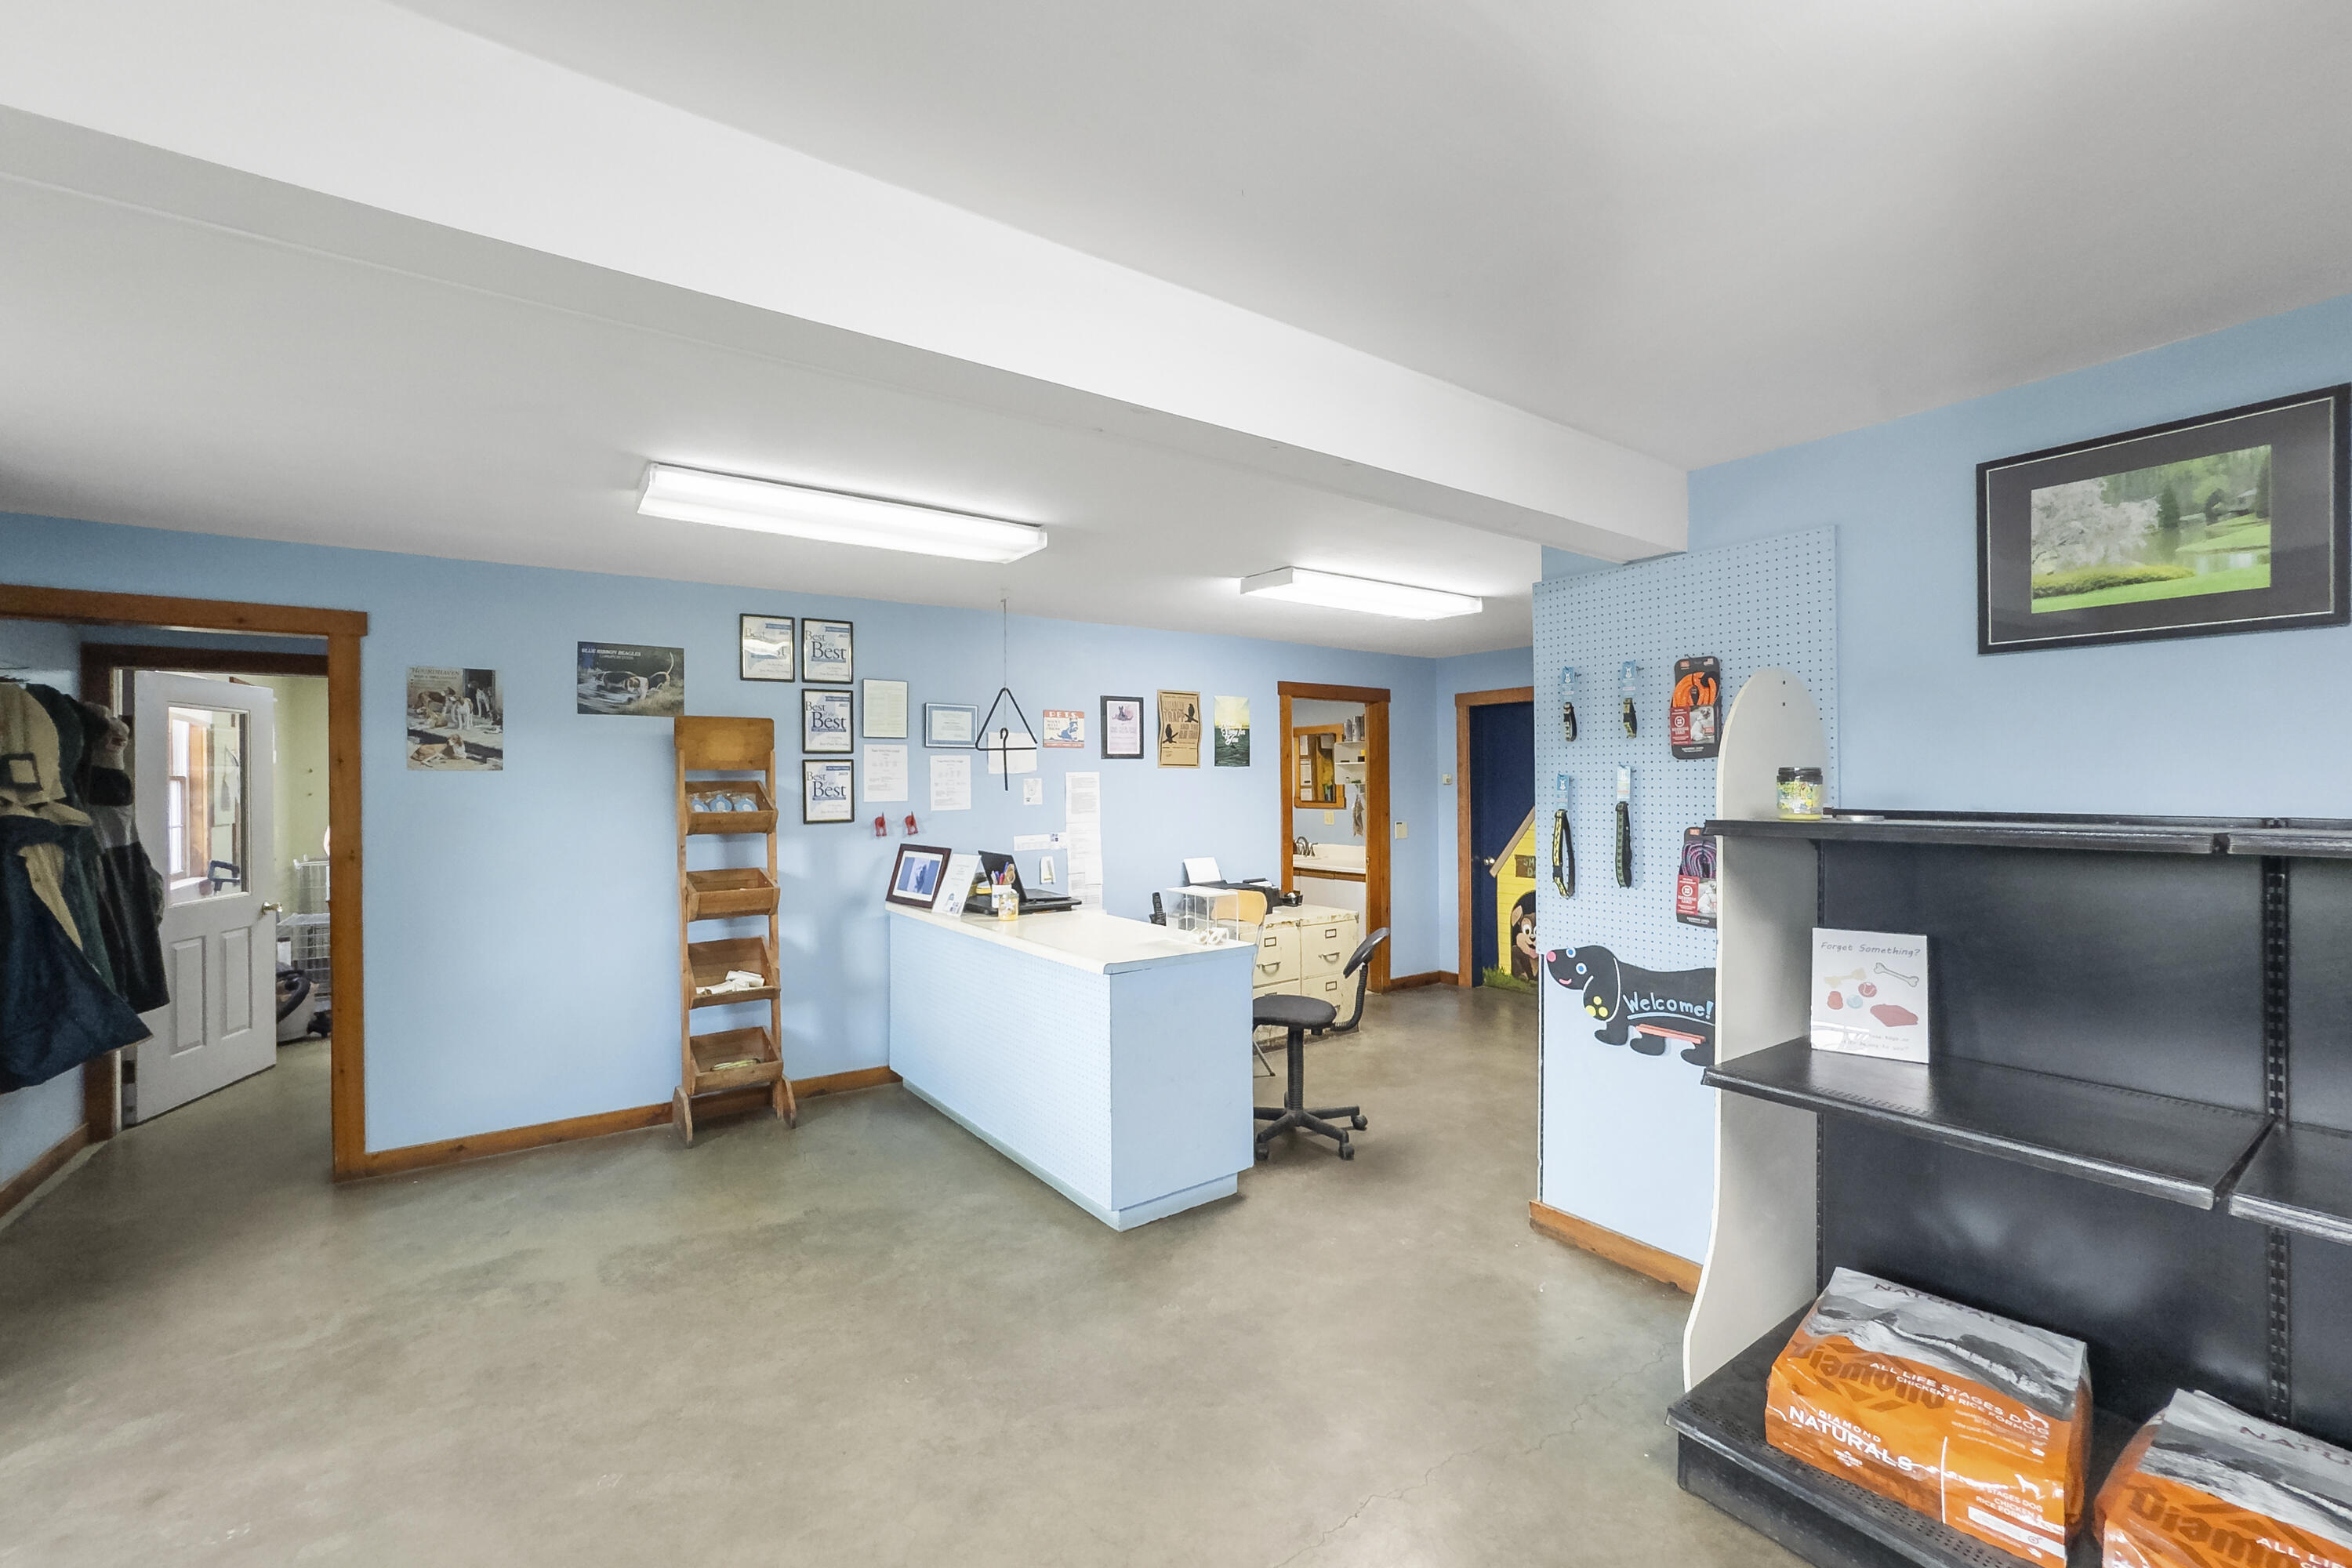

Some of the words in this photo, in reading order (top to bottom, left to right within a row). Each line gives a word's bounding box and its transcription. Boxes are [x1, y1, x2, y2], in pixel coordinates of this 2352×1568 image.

[805, 630, 826, 641] Best
[811, 641, 847, 660] Best
[805, 701, 826, 711] Best
[811, 711, 847, 729] Best
[807, 771, 826, 781] Best
[812, 781, 847, 797] Best
[1859, 944, 1921, 957] Something?
[1623, 991, 1714, 1019] Welcome!
[1870, 1363, 1897, 1374] ALL
[1902, 1370, 1937, 1387] LIFE
[1940, 1384, 2004, 1416] STAGES
[2009, 1413, 2050, 1436] DOG
[1896, 1376, 1945, 1398] CHICKEN
[1958, 1398, 1985, 1412] RICE
[1988, 1411, 2049, 1440] FORMULA
[1818, 1409, 1882, 1443] DIAMOND
[1976, 1496, 1995, 1509] RICE
[2022, 1499, 2043, 1512] DOG
[2256, 1538, 2300, 1559] ALL
